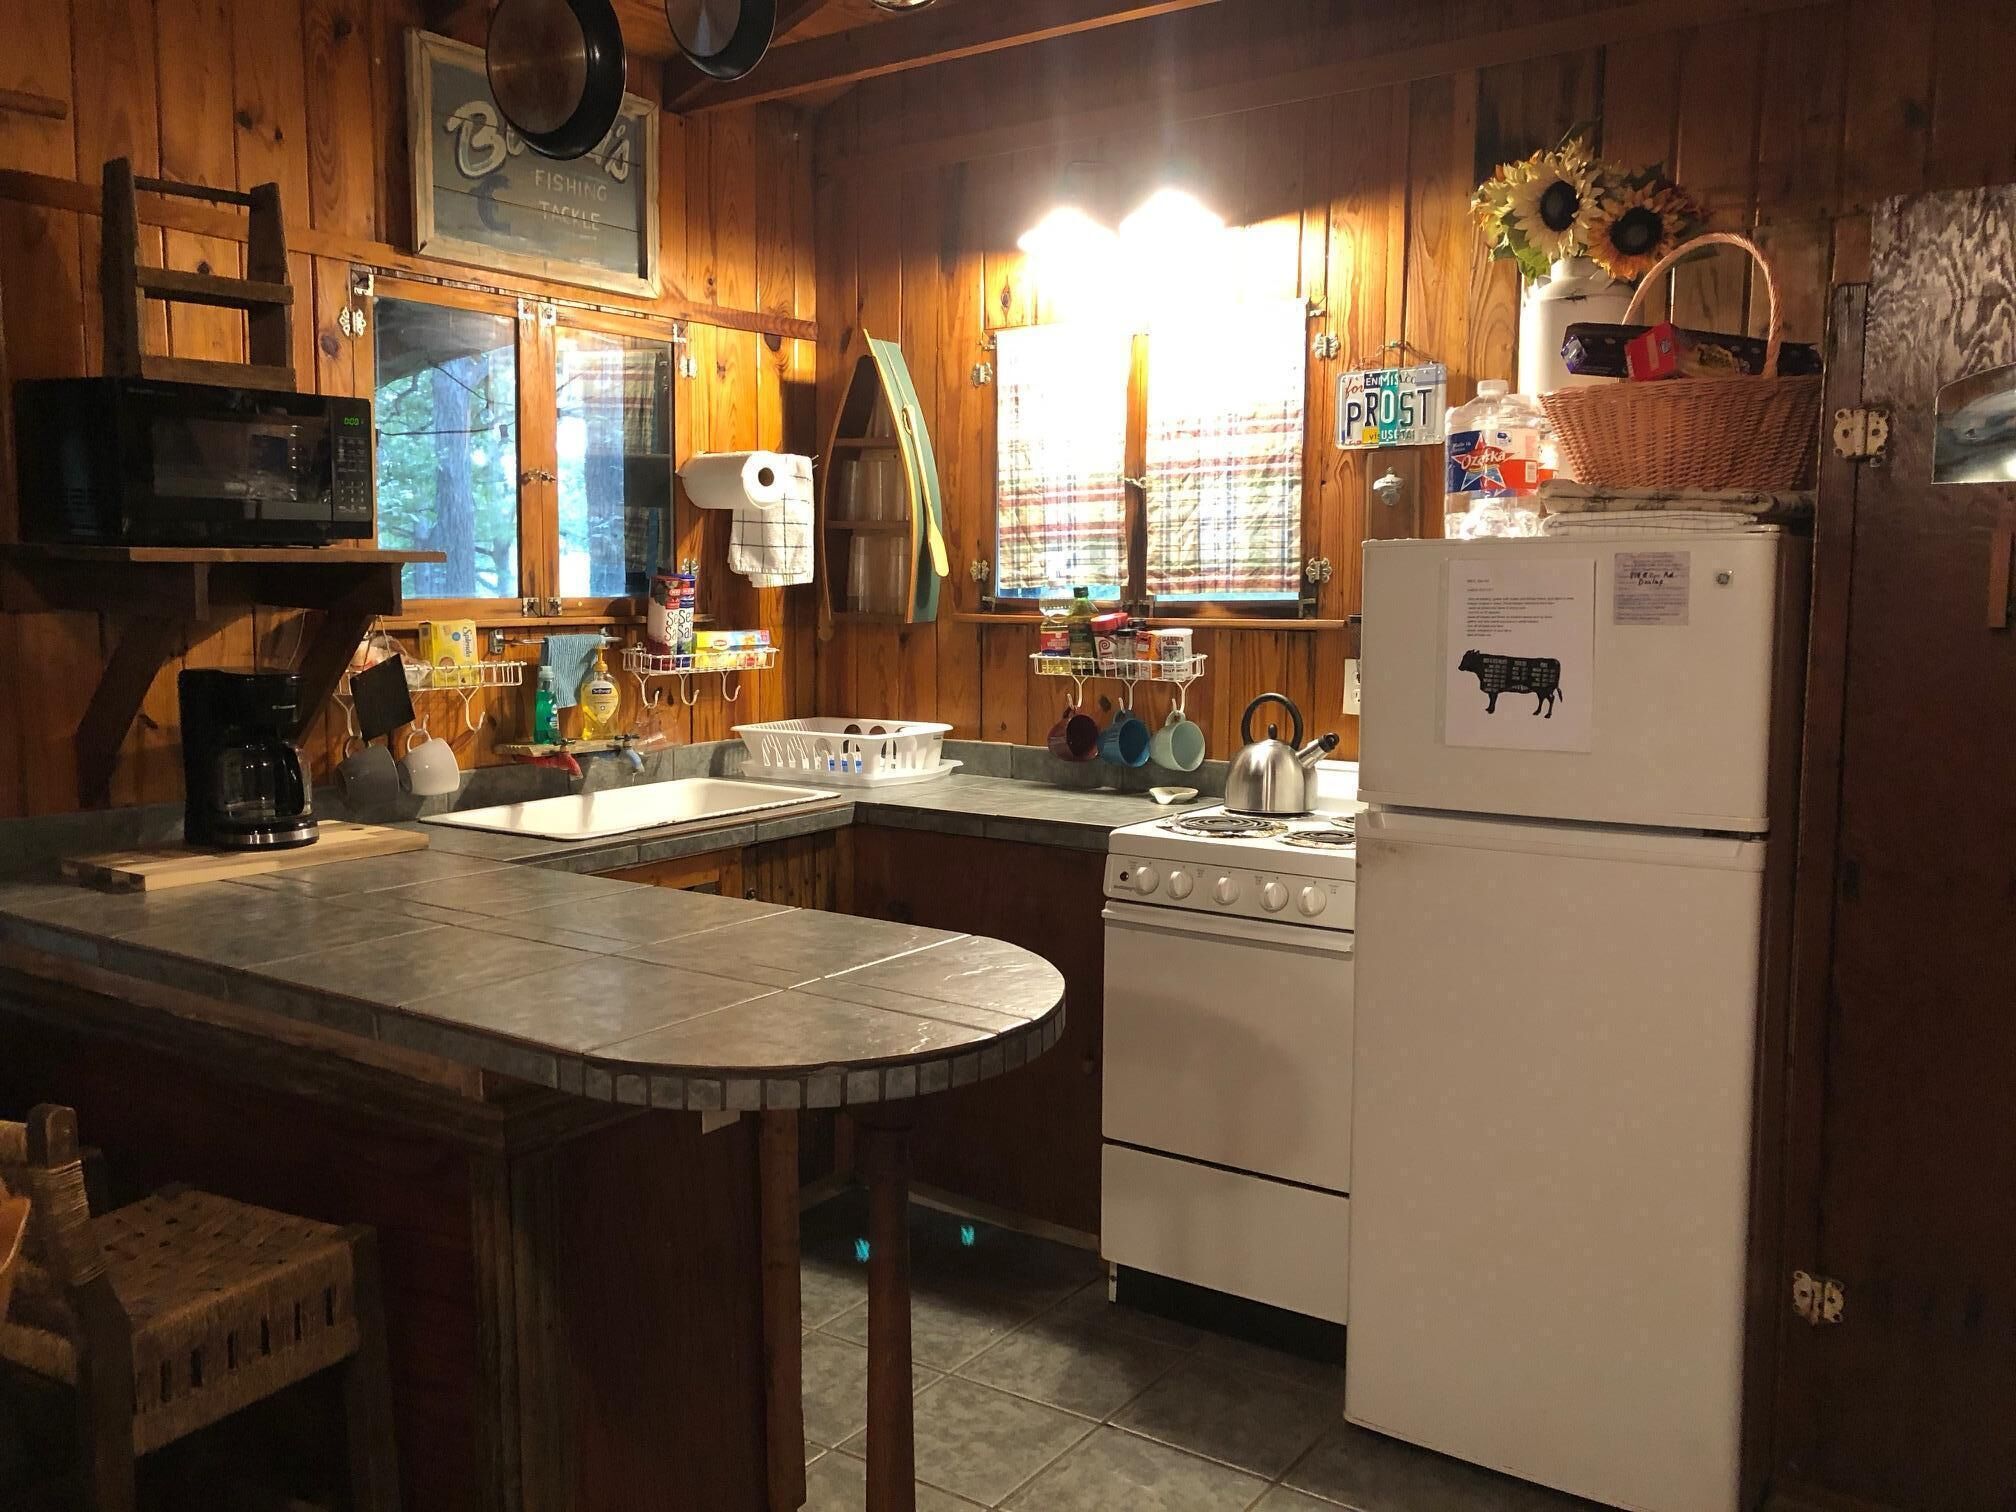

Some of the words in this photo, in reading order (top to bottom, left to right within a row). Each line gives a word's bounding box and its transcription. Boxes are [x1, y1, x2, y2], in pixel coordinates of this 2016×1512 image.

[535, 169, 607, 202] FISHING
[539, 200, 600, 231] TACKLE
[1345, 387, 1433, 437] PROST
[1461, 447, 1505, 470] Ozarka
[678, 610, 692, 625] Se
[463, 626, 472, 658] Splenda
